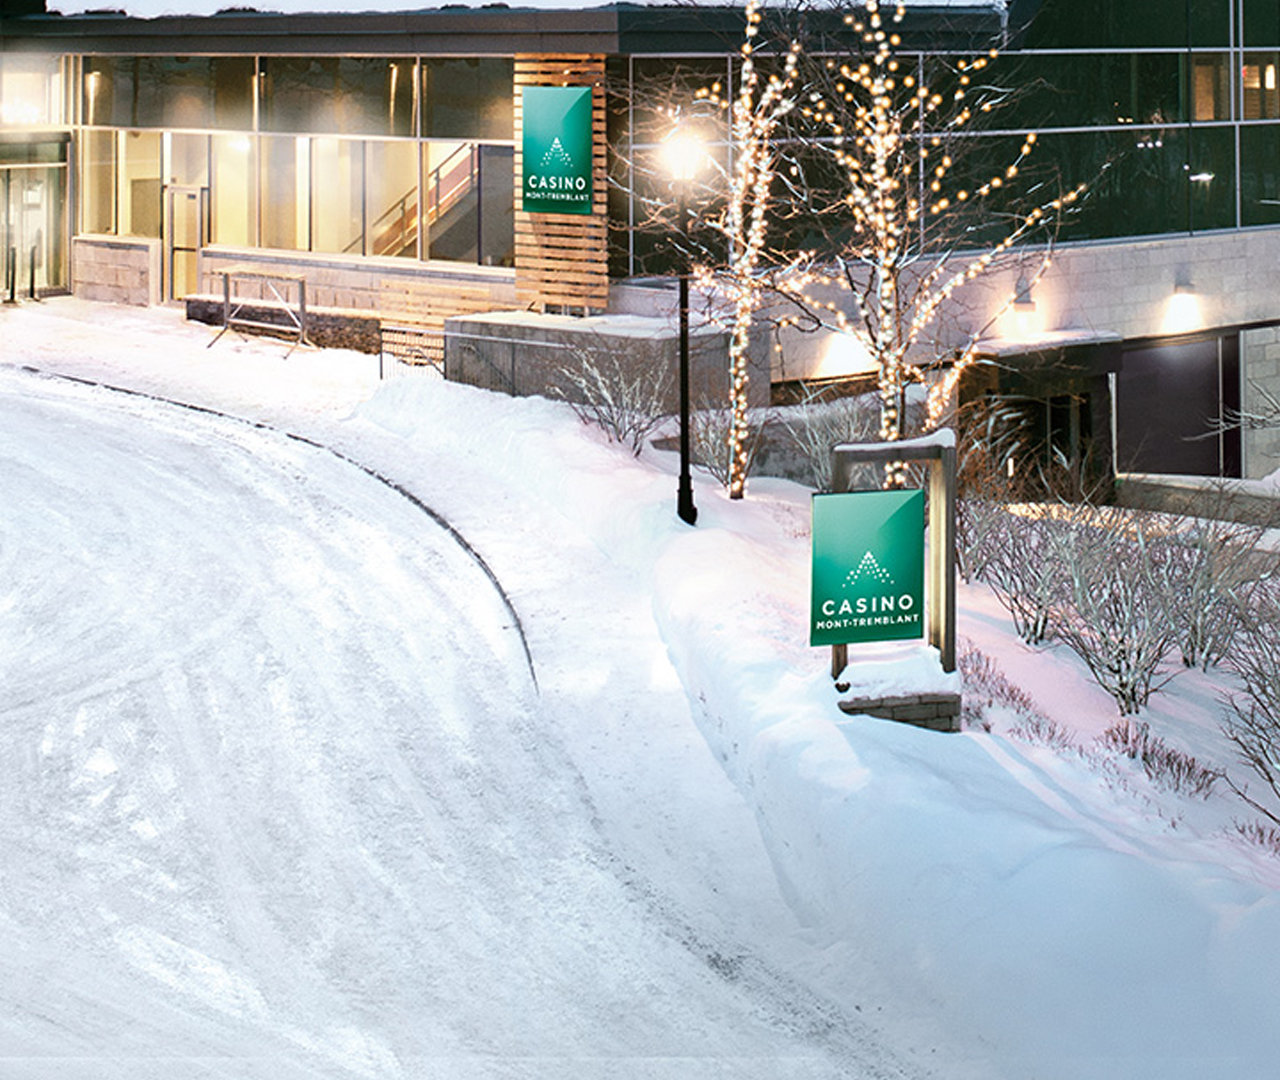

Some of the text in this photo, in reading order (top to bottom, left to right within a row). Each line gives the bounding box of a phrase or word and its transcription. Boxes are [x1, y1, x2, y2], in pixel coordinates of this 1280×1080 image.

[528, 175, 586, 191] CASINO
[822, 594, 913, 616] CASINO
[816, 614, 919, 629] MONT-TREMBLANT
